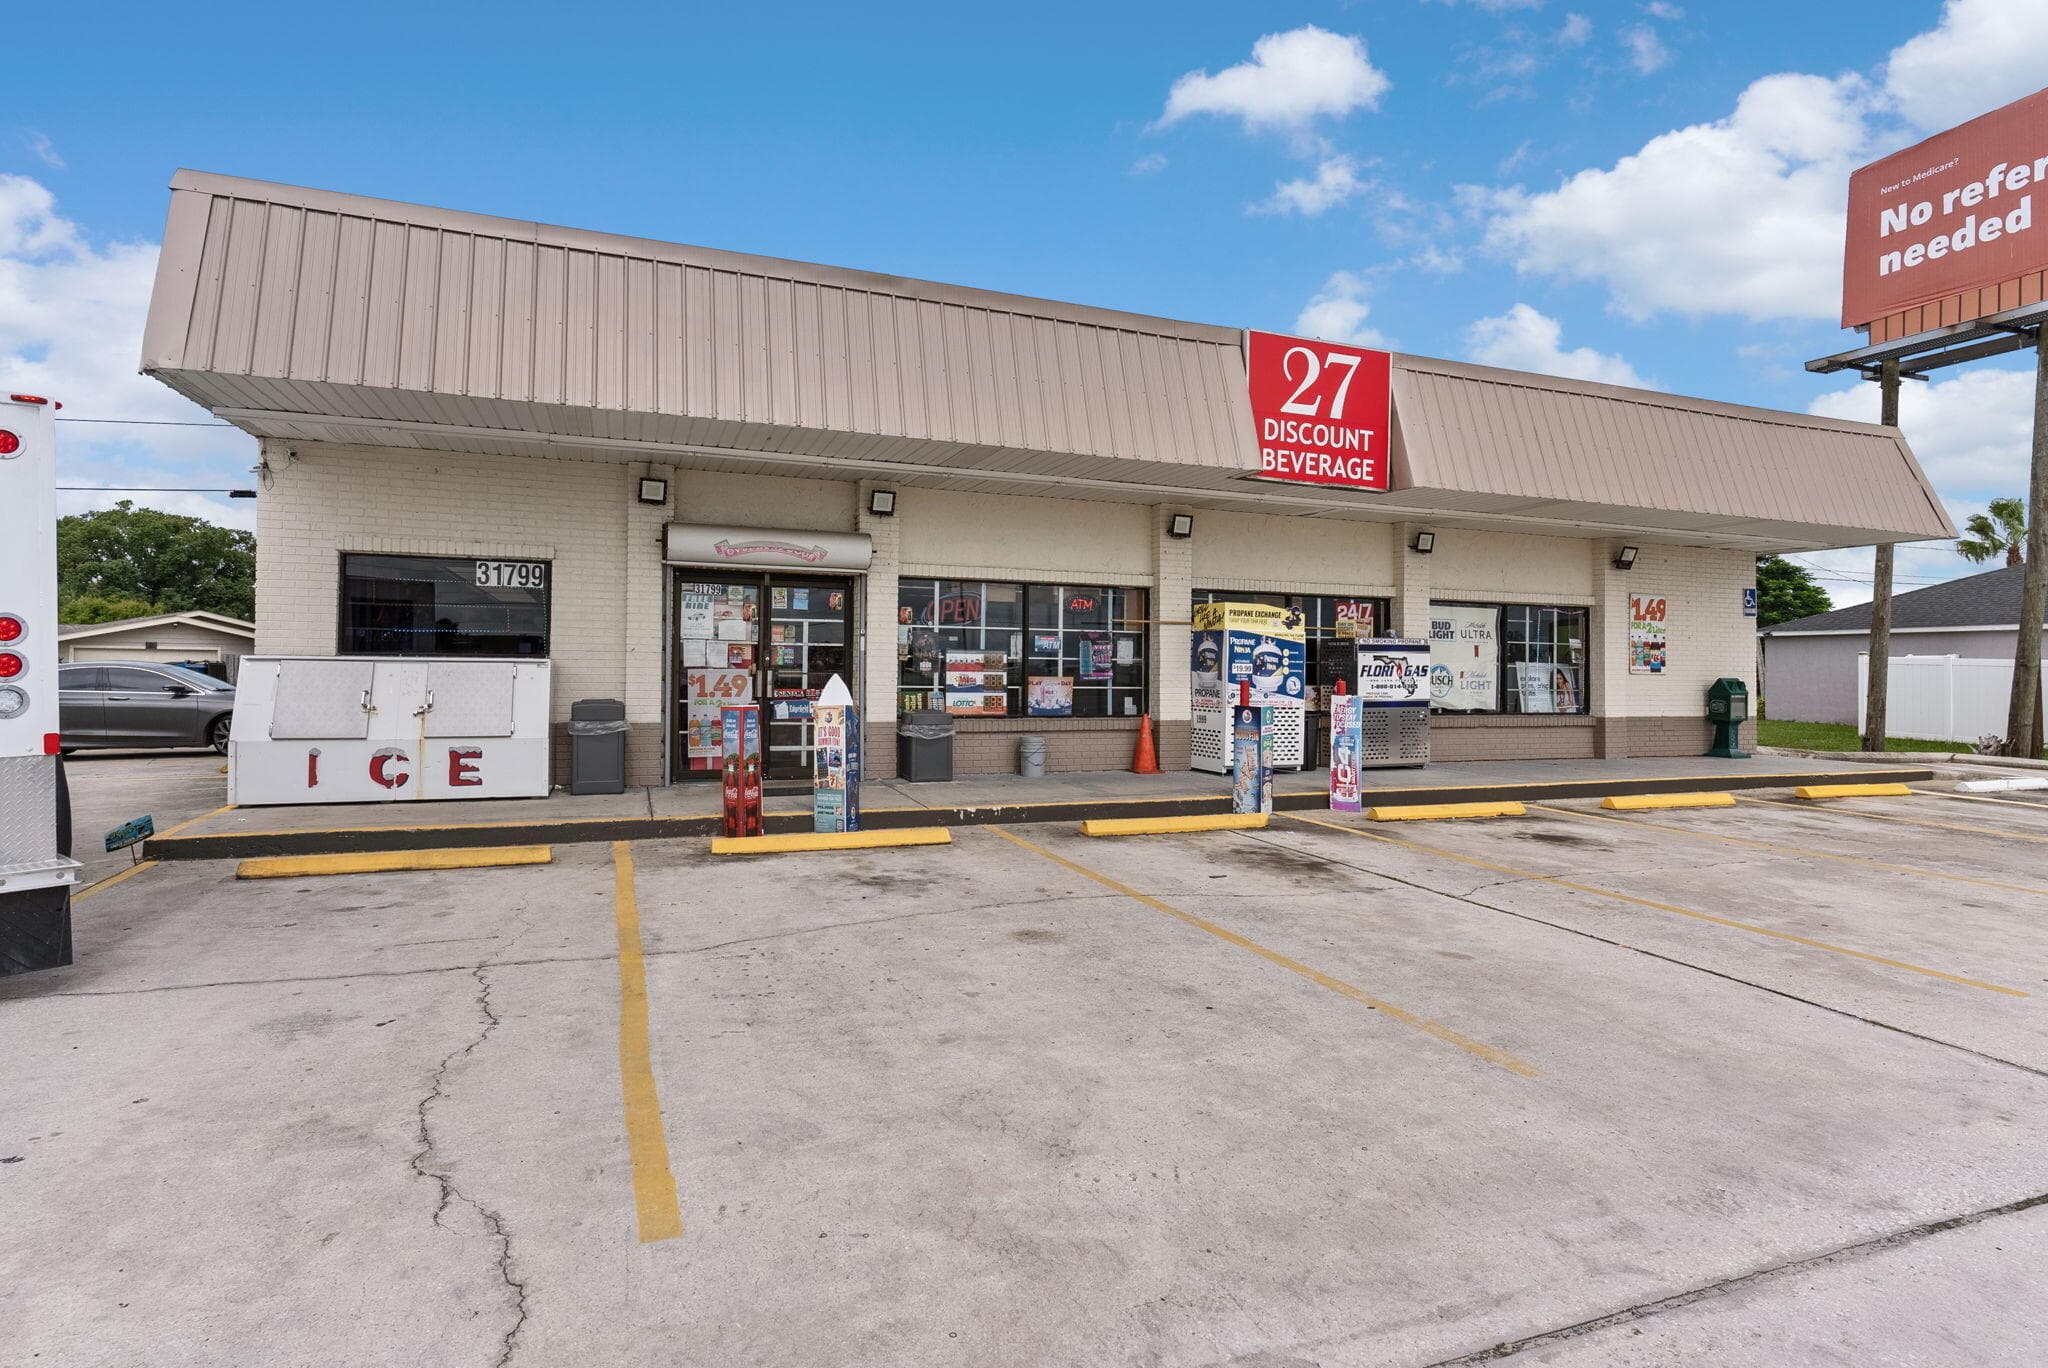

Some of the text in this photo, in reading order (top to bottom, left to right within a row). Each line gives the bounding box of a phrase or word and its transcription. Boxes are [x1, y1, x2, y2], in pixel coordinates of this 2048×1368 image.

[1880, 157, 1960, 195] New to Medicare?
[1880, 200, 1933, 238] No
[1879, 194, 2032, 277] needed
[1280, 346, 1362, 420] 27
[1264, 418, 1374, 452] DISCOUNT
[1262, 447, 1375, 481] BEVERAGE
[476, 562, 543, 587] 31799
[695, 584, 721, 595] 31799
[1070, 599, 1093, 610] ATM
[1229, 609, 1282, 620] PROPANE EXCHANGE
[1337, 603, 1372, 621] 24/7
[1431, 621, 1451, 631] BUD
[1646, 622, 1652, 634] 2
[1429, 630, 1454, 640] LIGHT
[1460, 629, 1492, 640] ULTRA
[1043, 642, 1060, 650] ATM
[1229, 636, 1256, 646] PROPANE
[1234, 646, 1251, 654] NINJA
[1360, 664, 1429, 677] FLORI GAS
[688, 674, 748, 698] $1.49
[1431, 675, 1454, 686] USCH
[1460, 680, 1492, 690] LIGHT
[1194, 688, 1221, 698] PROPANE
[308, 747, 483, 788] ICE
